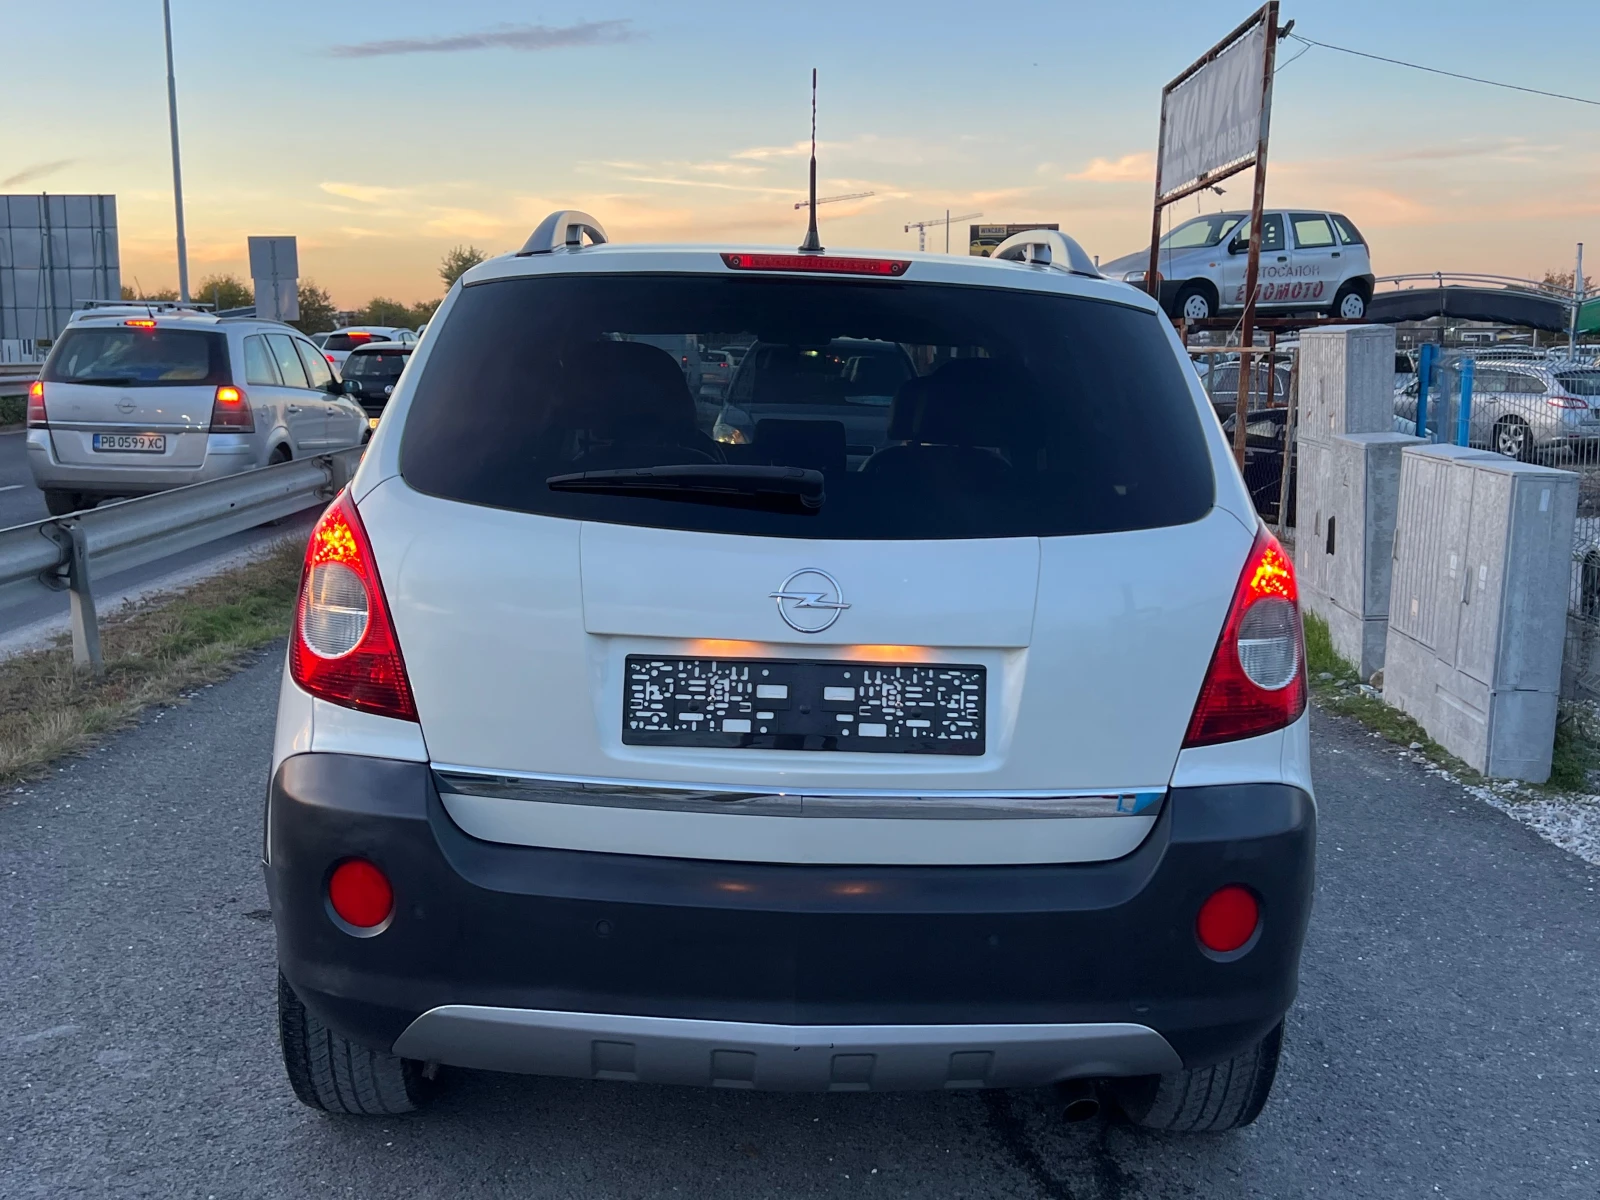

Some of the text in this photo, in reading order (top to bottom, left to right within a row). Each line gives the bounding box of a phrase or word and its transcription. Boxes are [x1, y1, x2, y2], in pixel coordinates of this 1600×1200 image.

[1242, 264, 1320, 279] ТОСАЛОН
[101, 436, 162, 449] PB 0599 XC
